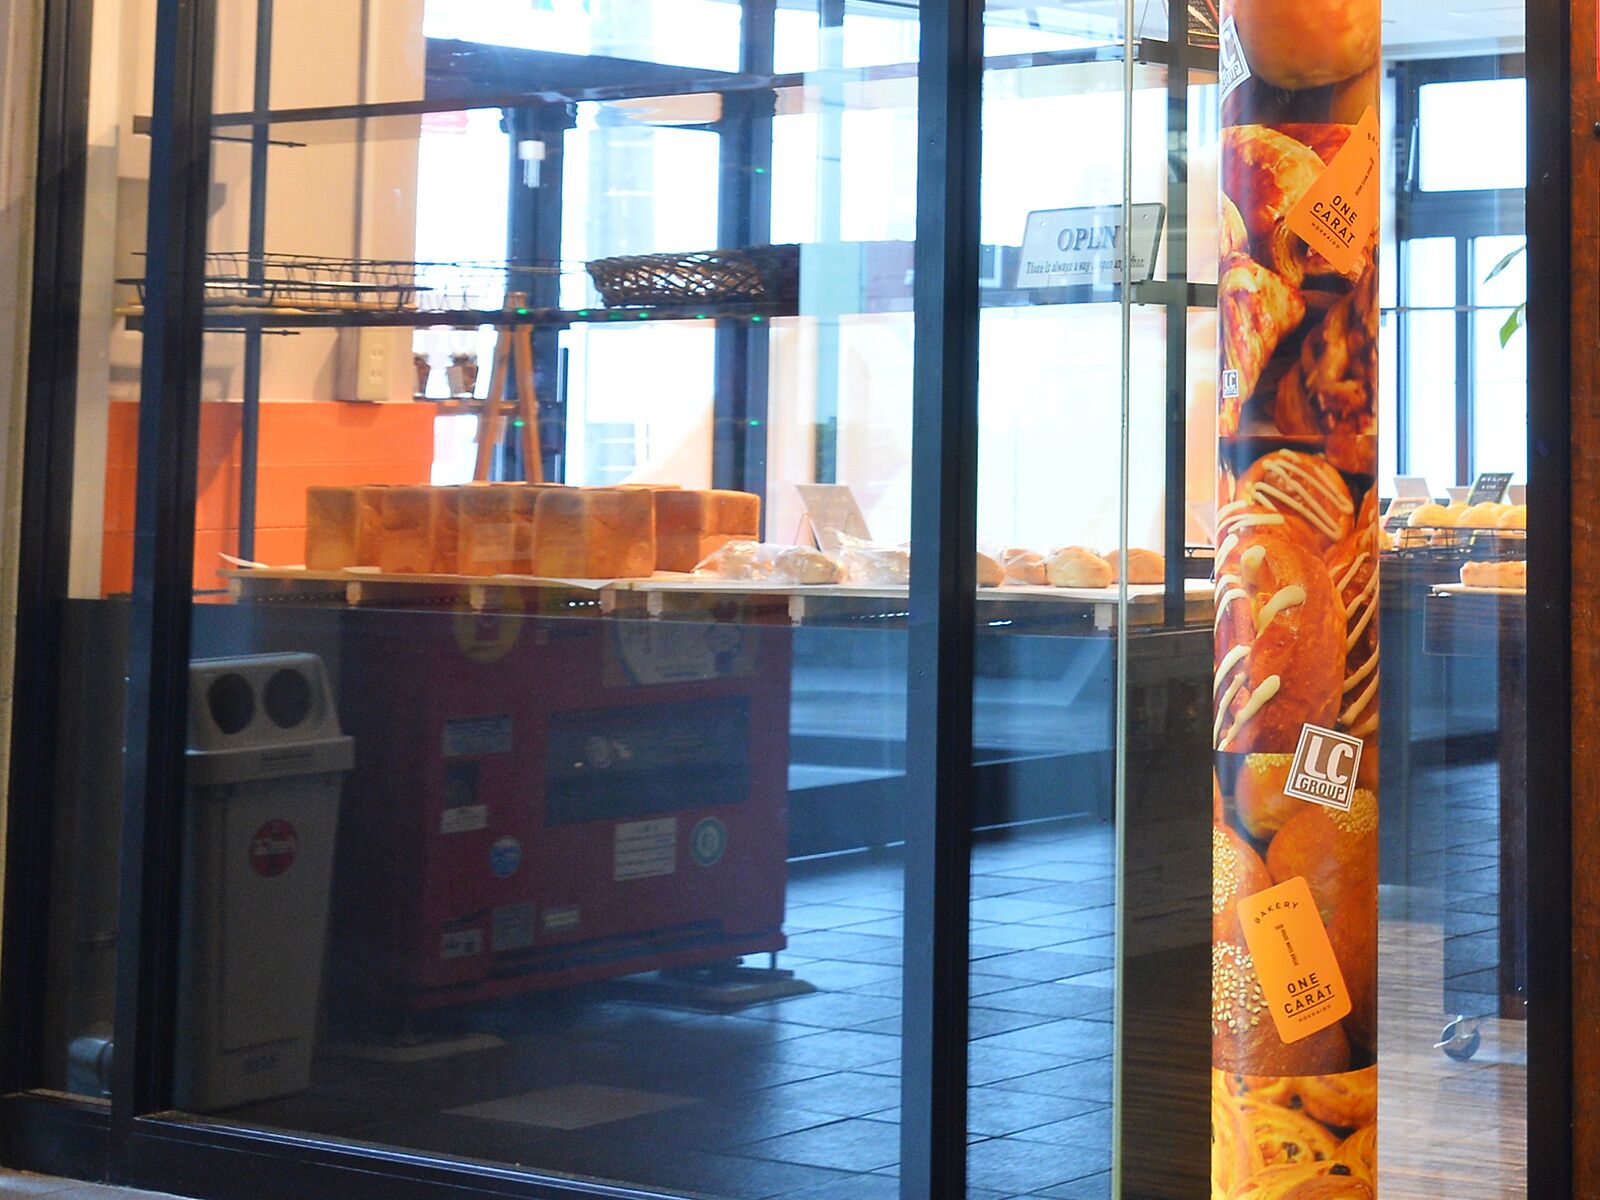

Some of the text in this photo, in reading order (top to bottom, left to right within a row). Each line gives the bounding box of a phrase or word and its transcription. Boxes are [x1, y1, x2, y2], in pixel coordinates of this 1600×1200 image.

[1313, 202, 1355, 243] CARAT
[1332, 195, 1358, 224] ONE
[1304, 735, 1354, 784] LC
[1300, 777, 1344, 800] GROUP
[1254, 901, 1299, 925] BAKERY
[1287, 973, 1319, 993] ONE
[1284, 984, 1332, 1014] CARAT
